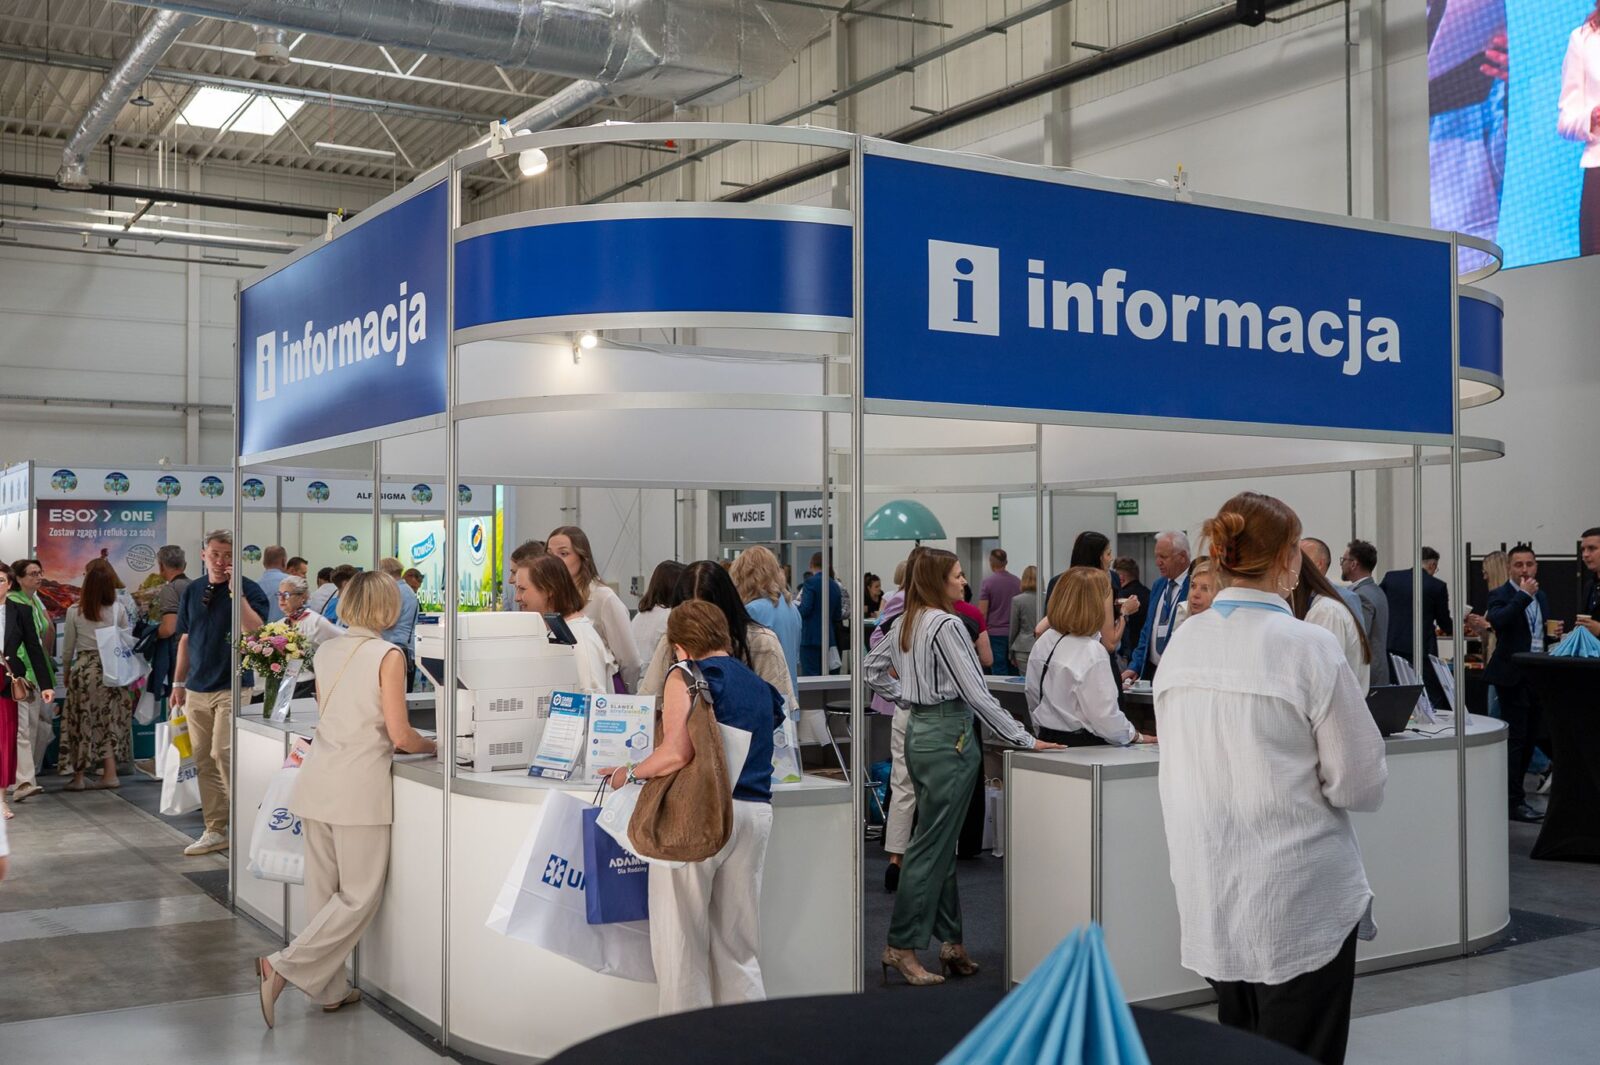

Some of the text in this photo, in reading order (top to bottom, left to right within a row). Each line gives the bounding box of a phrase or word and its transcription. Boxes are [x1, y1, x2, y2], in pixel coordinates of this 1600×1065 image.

[1027, 258, 1402, 377] informacja
[282, 281, 427, 385] informacja
[356, 492, 407, 501] ALFSIGMA
[120, 510, 153, 522] ONE
[732, 508, 766, 523] WYJŚCIE
[48, 527, 75, 537] Zostaw
[76, 529, 97, 538] zgagę
[104, 527, 128, 537] refluks
[140, 527, 156, 538] sobą
[292, 820, 304, 836] S
[609, 856, 647, 869] ADAM
